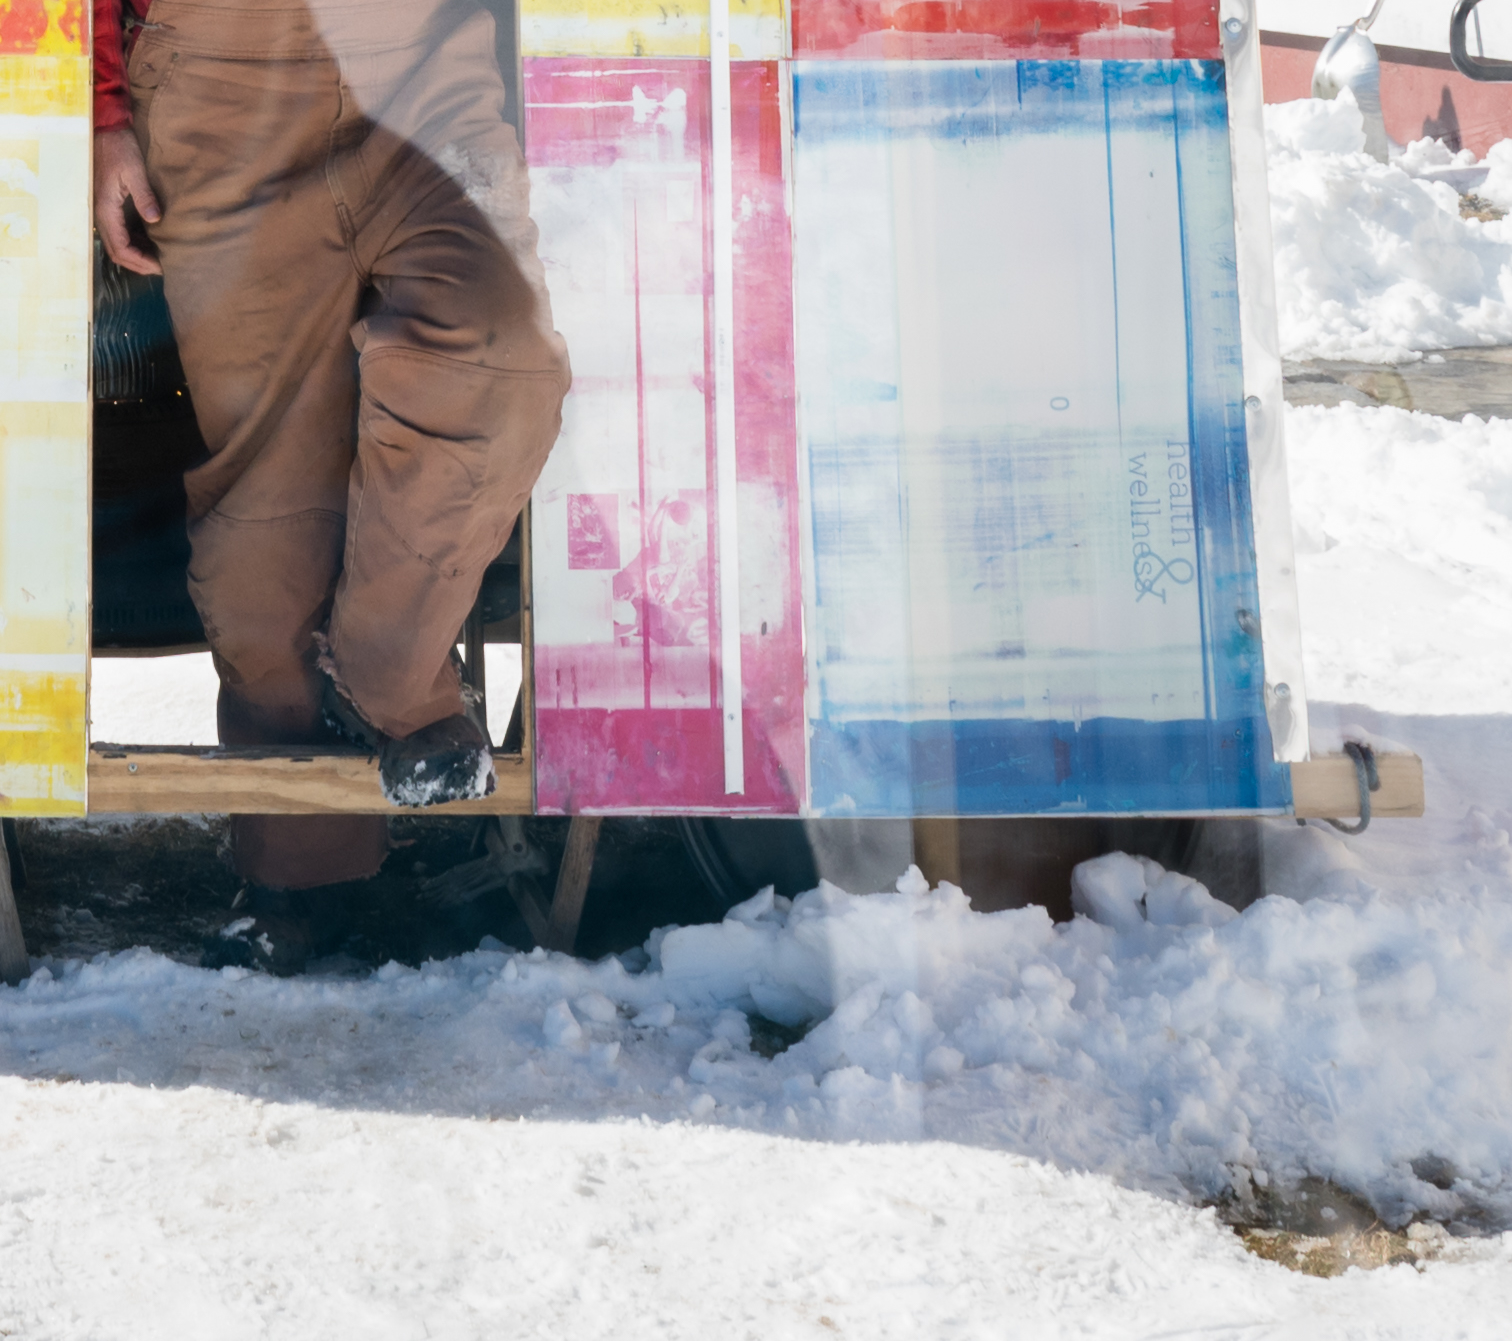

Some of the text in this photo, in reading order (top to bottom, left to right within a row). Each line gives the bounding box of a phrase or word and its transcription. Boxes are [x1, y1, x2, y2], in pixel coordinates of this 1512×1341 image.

[1128, 452, 1161, 593] wellness
[1133, 440, 1195, 604] health &
